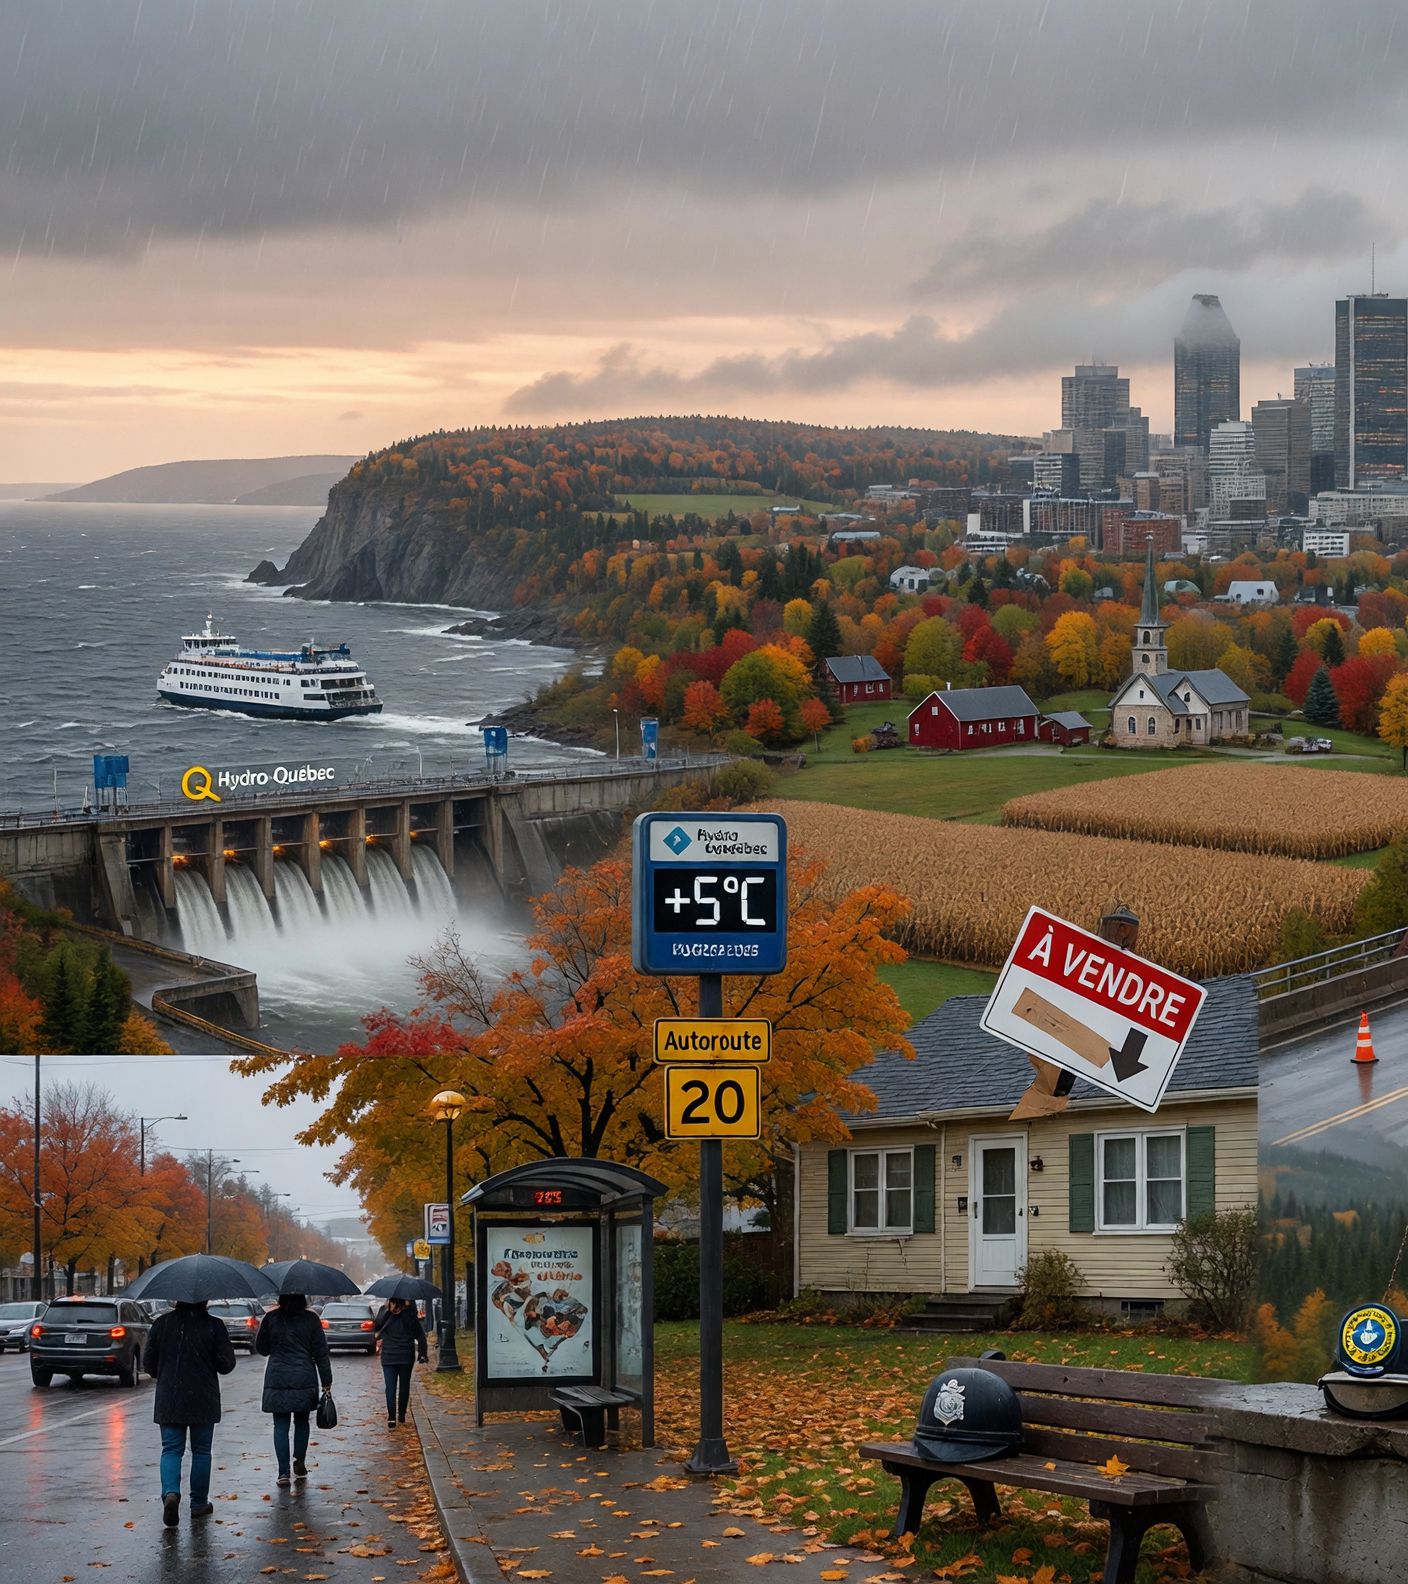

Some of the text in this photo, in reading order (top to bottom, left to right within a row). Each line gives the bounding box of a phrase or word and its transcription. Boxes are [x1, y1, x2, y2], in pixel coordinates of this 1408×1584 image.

[1027, 925, 1187, 1028] À VENDRE
[664, 1030, 762, 1052] Autoroute
[680, 1079, 746, 1125] 20
